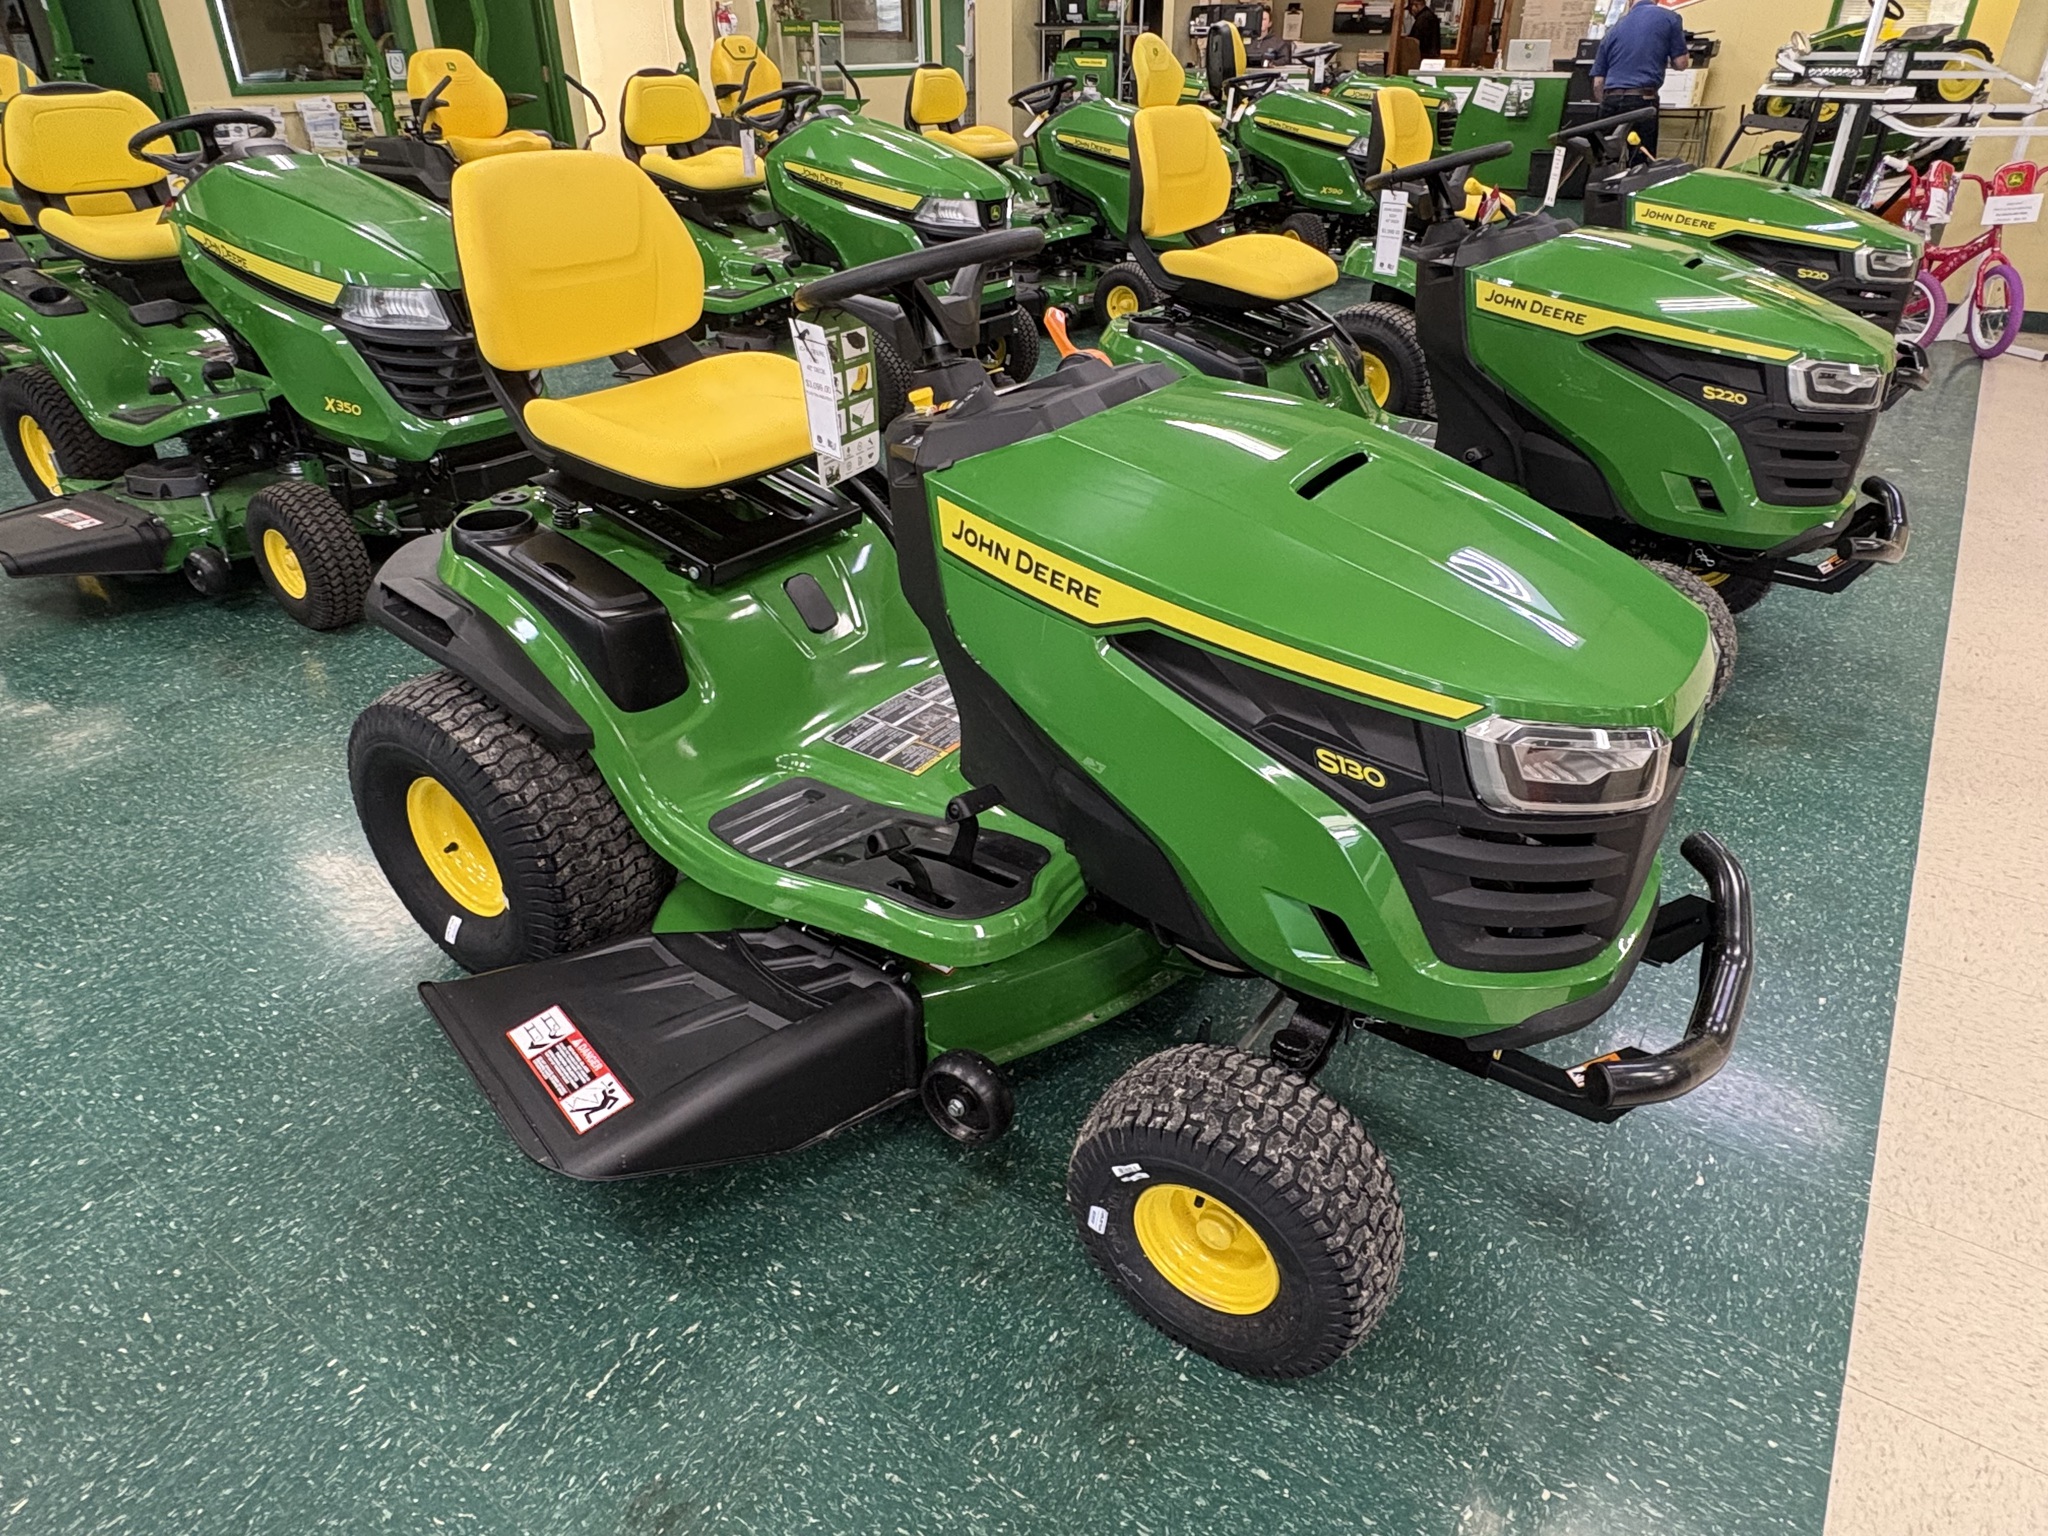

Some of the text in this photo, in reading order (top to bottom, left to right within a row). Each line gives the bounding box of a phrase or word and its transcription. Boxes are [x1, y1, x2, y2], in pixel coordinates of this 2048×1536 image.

[802, 168, 844, 189] JOHN DEERE
[1641, 208, 1717, 231] JOHN DEERE
[1797, 268, 1829, 281] S220
[1484, 289, 1587, 326] JOHN DEERE
[324, 396, 362, 416] X350
[1702, 385, 1748, 405] S220
[951, 519, 1102, 609] JOHN DEERE
[1315, 748, 1386, 788] S130
[577, 1043, 604, 1072] DANGER
